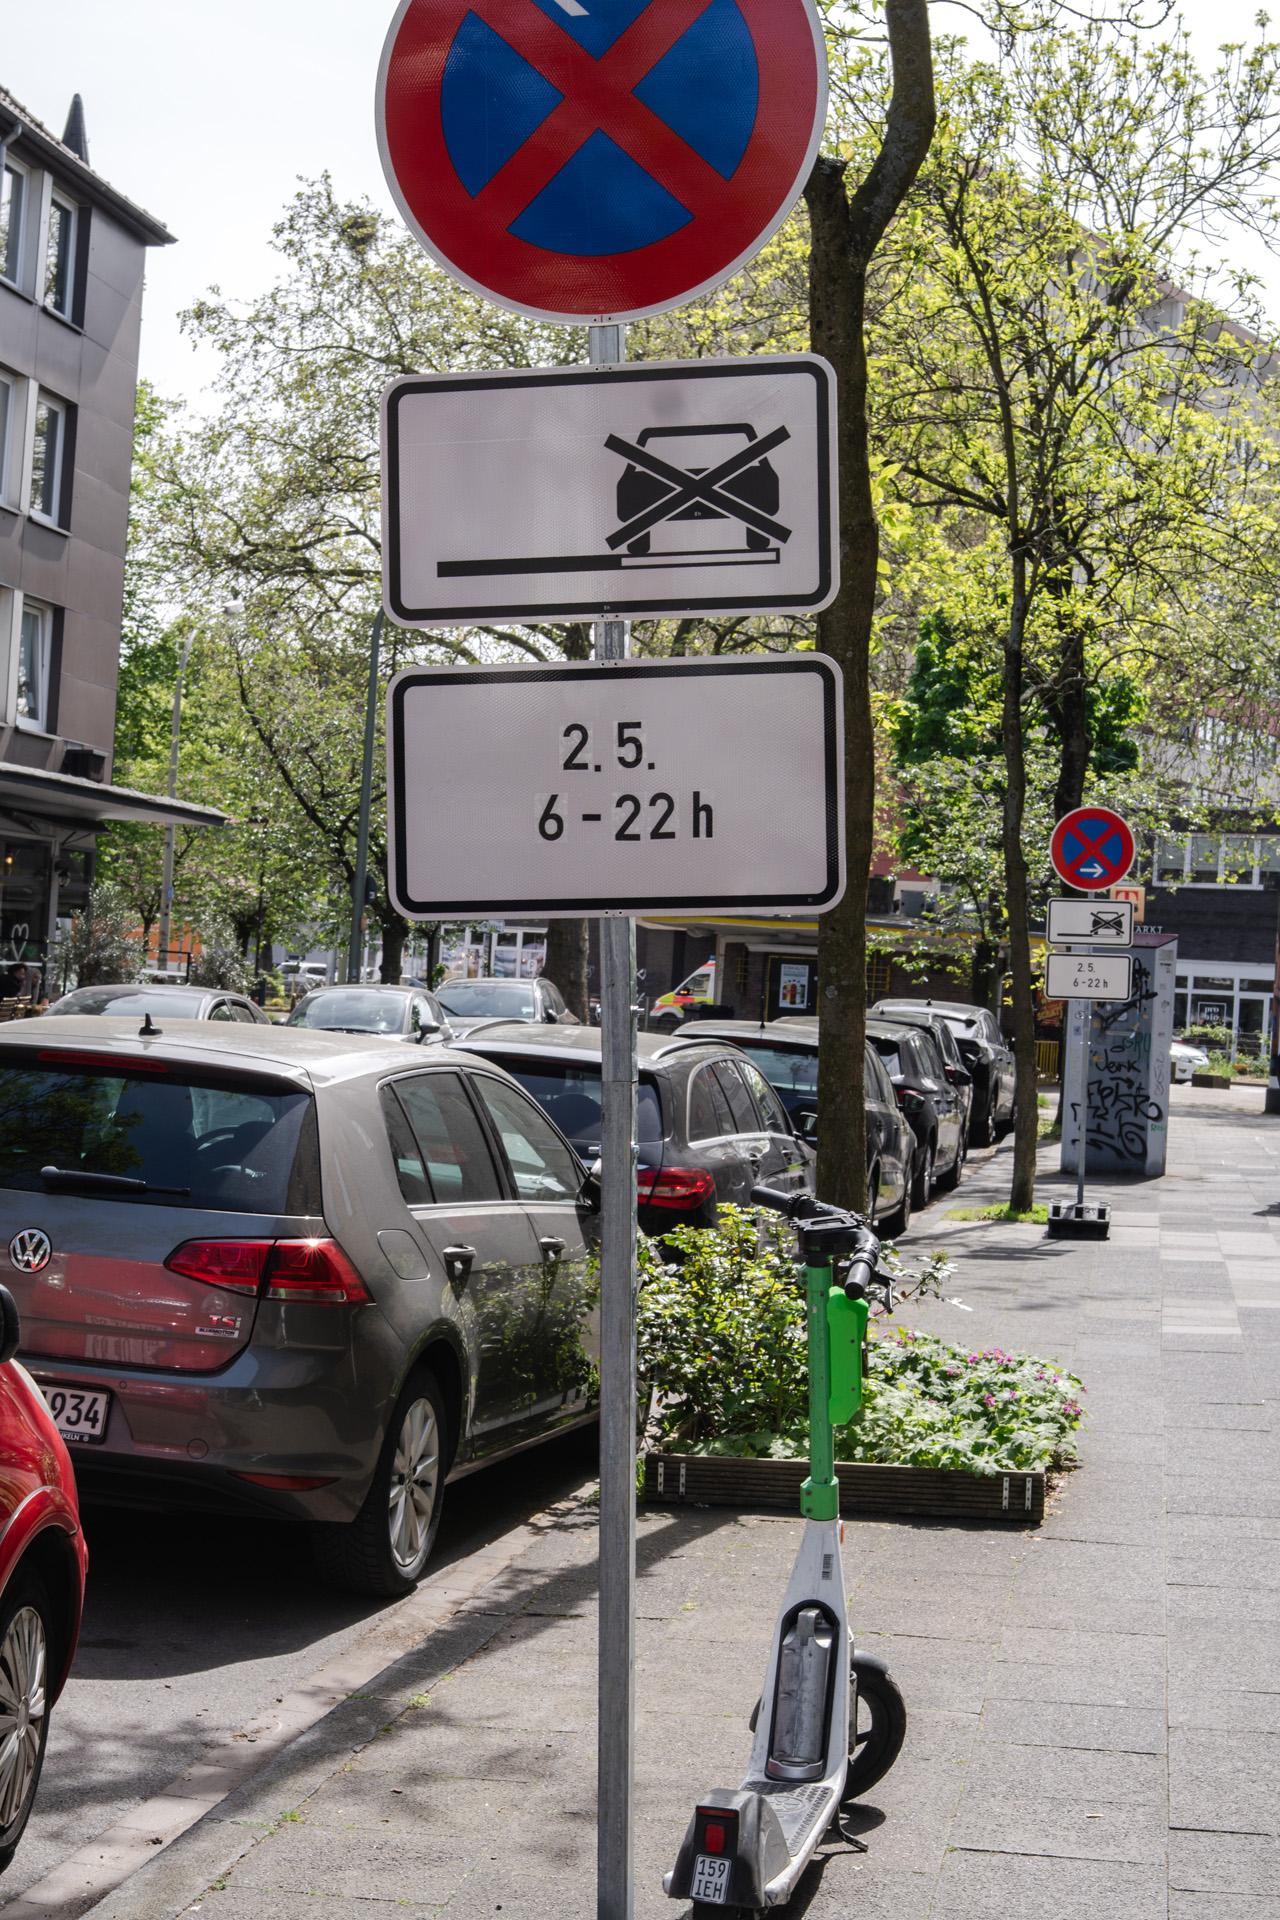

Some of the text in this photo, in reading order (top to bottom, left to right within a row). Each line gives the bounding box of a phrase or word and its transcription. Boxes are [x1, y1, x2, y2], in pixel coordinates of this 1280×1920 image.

[42, 1391, 99, 1429] 934
[698, 1859, 726, 1878] 159
[695, 1880, 723, 1899] IEH
